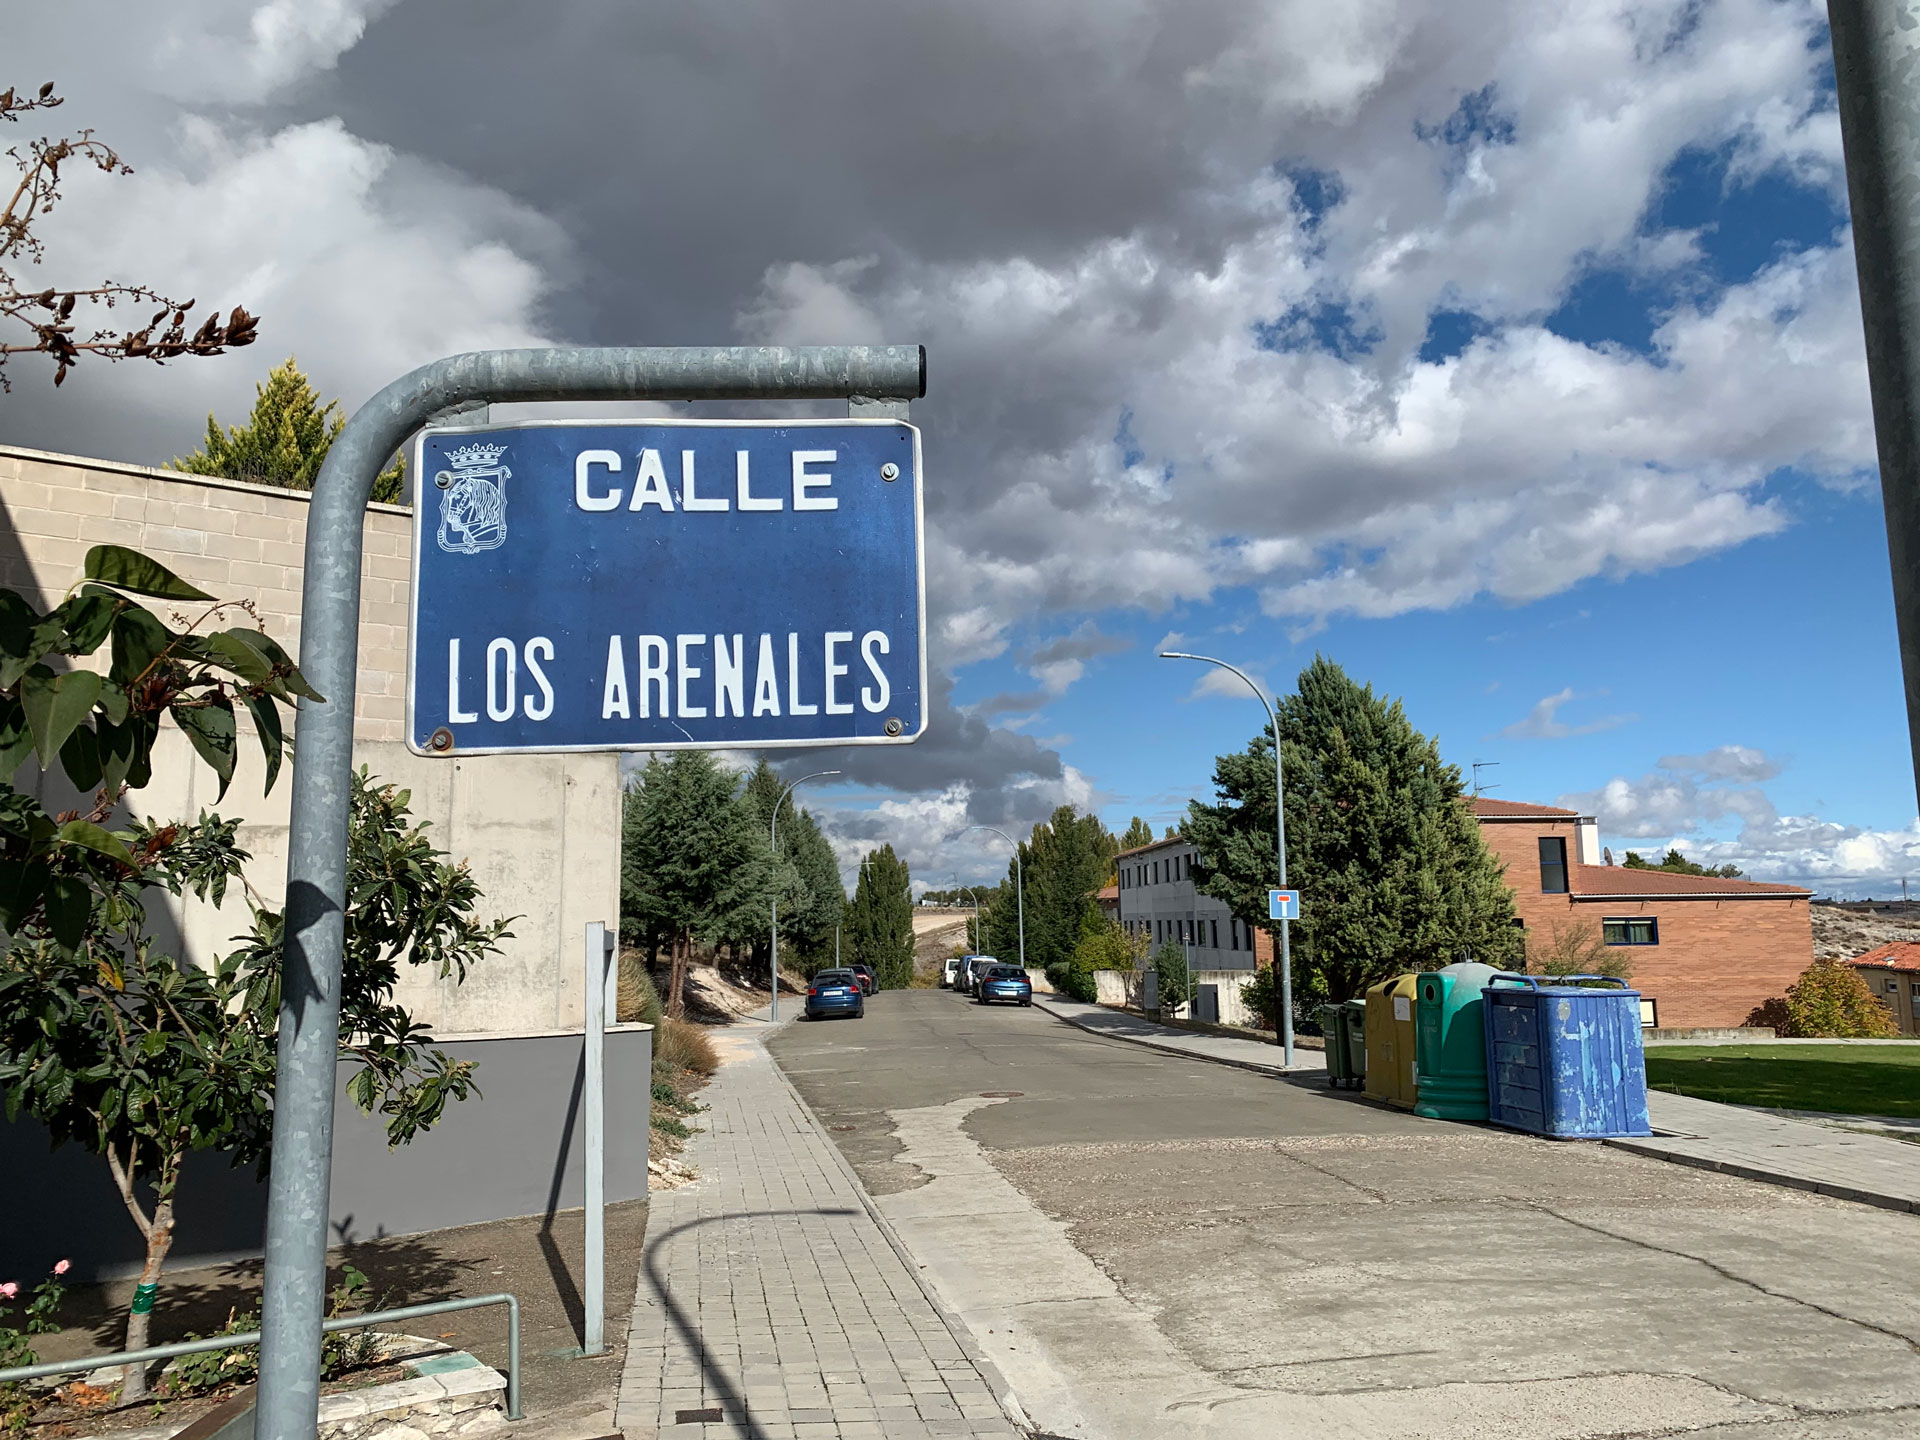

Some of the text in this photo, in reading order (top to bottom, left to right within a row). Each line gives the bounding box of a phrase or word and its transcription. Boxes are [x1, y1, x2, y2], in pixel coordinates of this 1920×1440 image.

[575, 449, 839, 512] CALLE
[448, 630, 892, 724] LOS ARENALES
